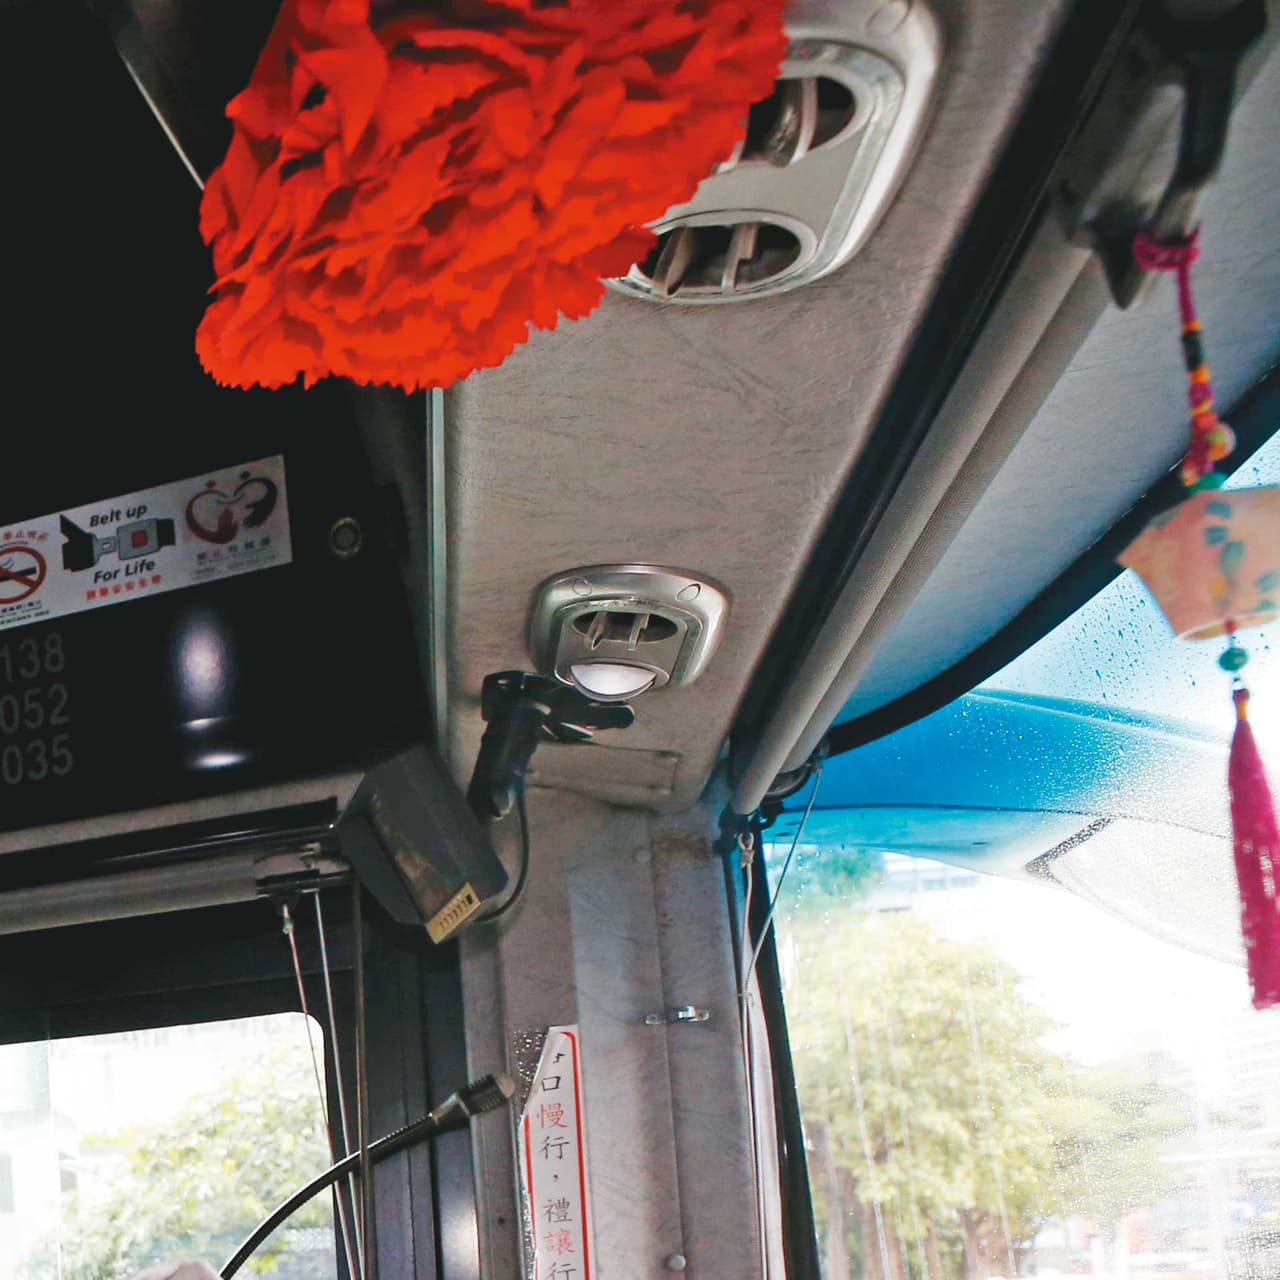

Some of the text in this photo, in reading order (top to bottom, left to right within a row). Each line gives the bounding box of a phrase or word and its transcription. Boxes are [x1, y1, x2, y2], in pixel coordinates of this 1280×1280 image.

[89, 505, 148, 527] Belt up
[93, 559, 156, 584] For Life
